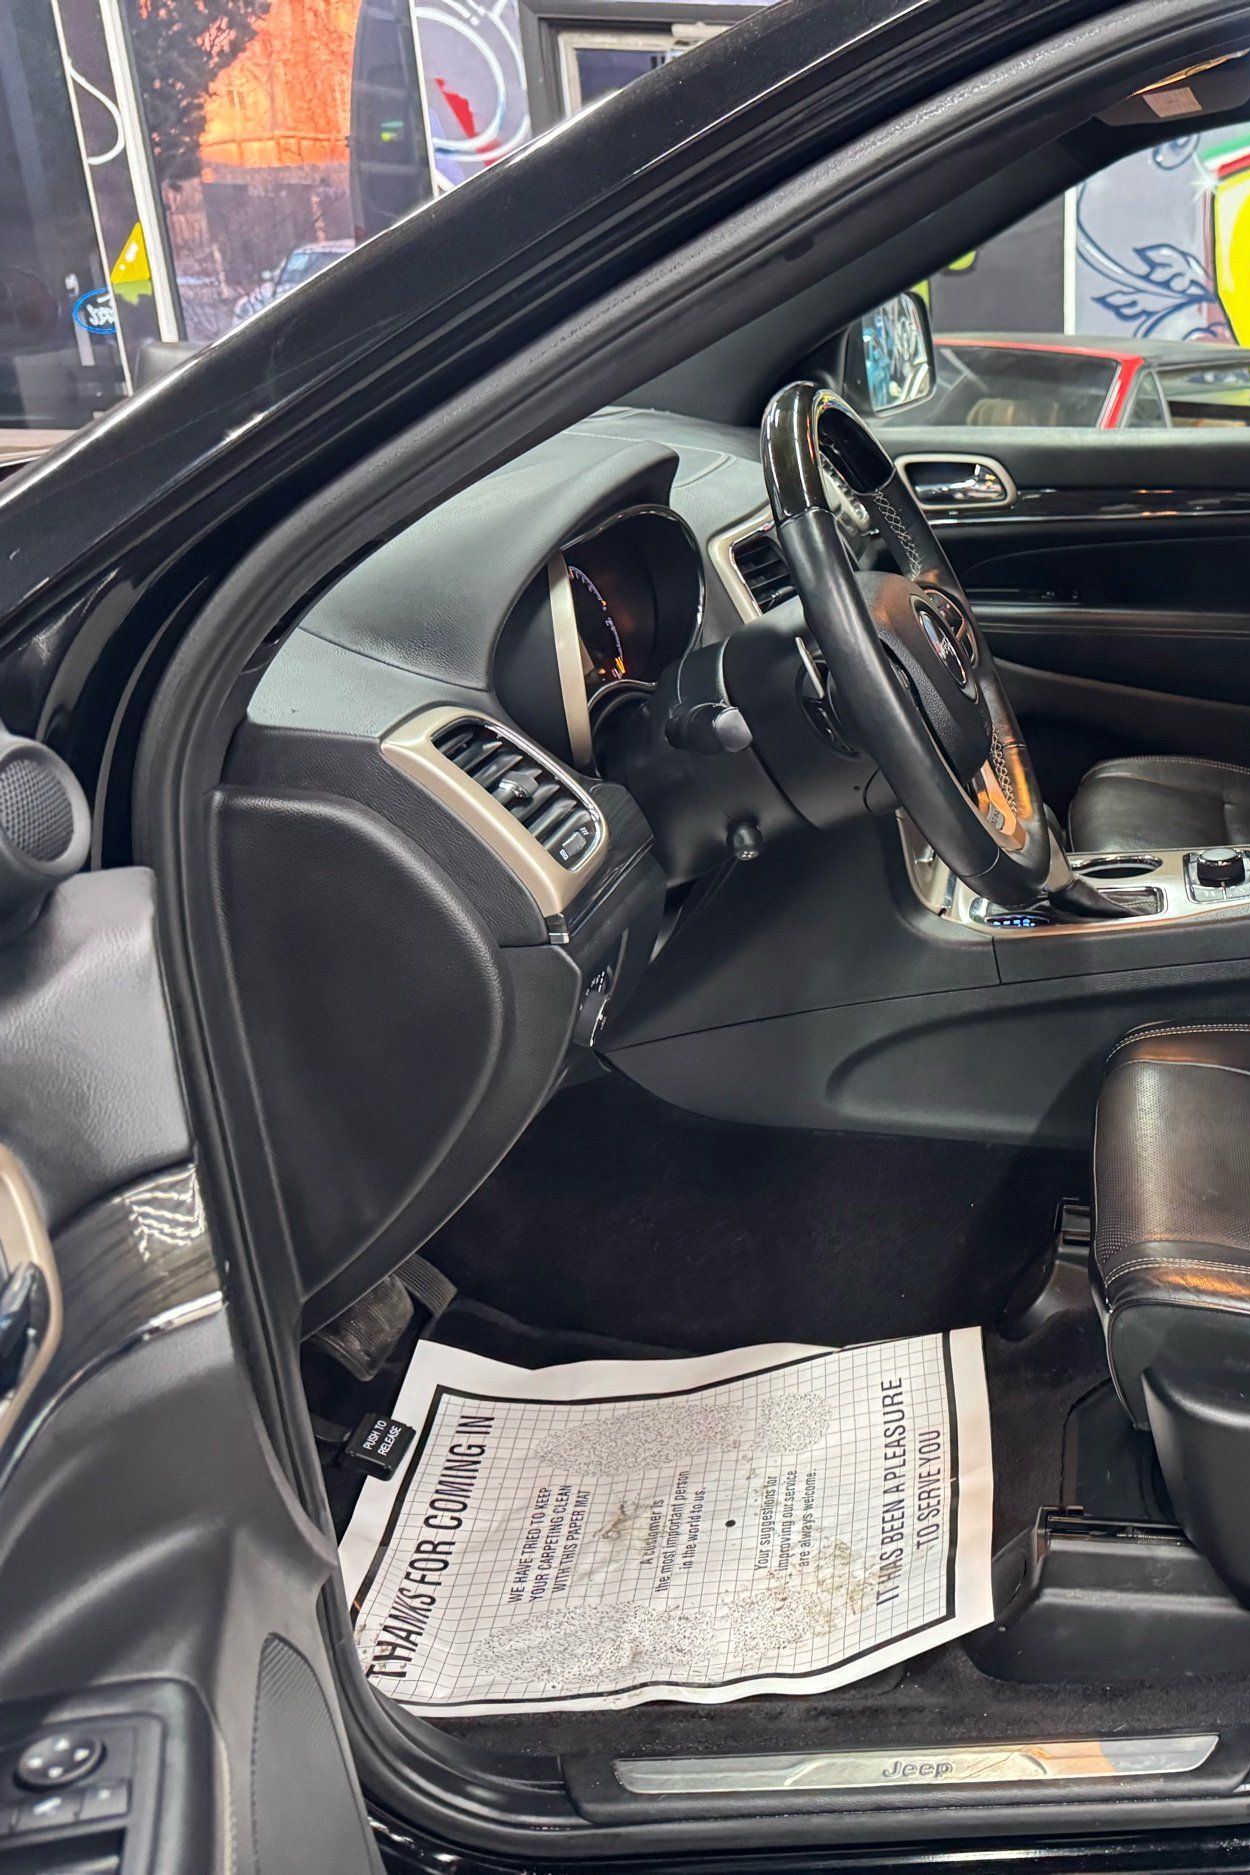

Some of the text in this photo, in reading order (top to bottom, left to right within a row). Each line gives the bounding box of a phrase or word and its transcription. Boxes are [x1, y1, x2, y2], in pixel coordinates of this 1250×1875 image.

[362, 1420, 387, 1450] PUSH TO
[377, 1425, 402, 1456] RELEASE
[643, 1511, 662, 1556] customer
[650, 1499, 665, 1509] is
[654, 1470, 690, 1593] the most important person
[679, 1487, 706, 1570] in the world to us.
[760, 1489, 776, 1546] suggestions
[775, 1470, 797, 1572] improving our service
[799, 1468, 817, 1567] are always welcome.
[876, 1377, 906, 1606] IT HAS BEEN A PLEASURE
[916, 1430, 942, 1550] TO SERVE YOU
[366, 1415, 495, 1678] THANKS FOR COMING IN
[507, 1487, 552, 1604] WE HAVE TRIED TO KEEP
[529, 1485, 573, 1602] YOUR CARPETING CLEAN
[552, 1490, 591, 1593] WITH THIS PAPER MAT
[754, 1549, 771, 1571] Your
[882, 1760, 953, 1778] Jeep
